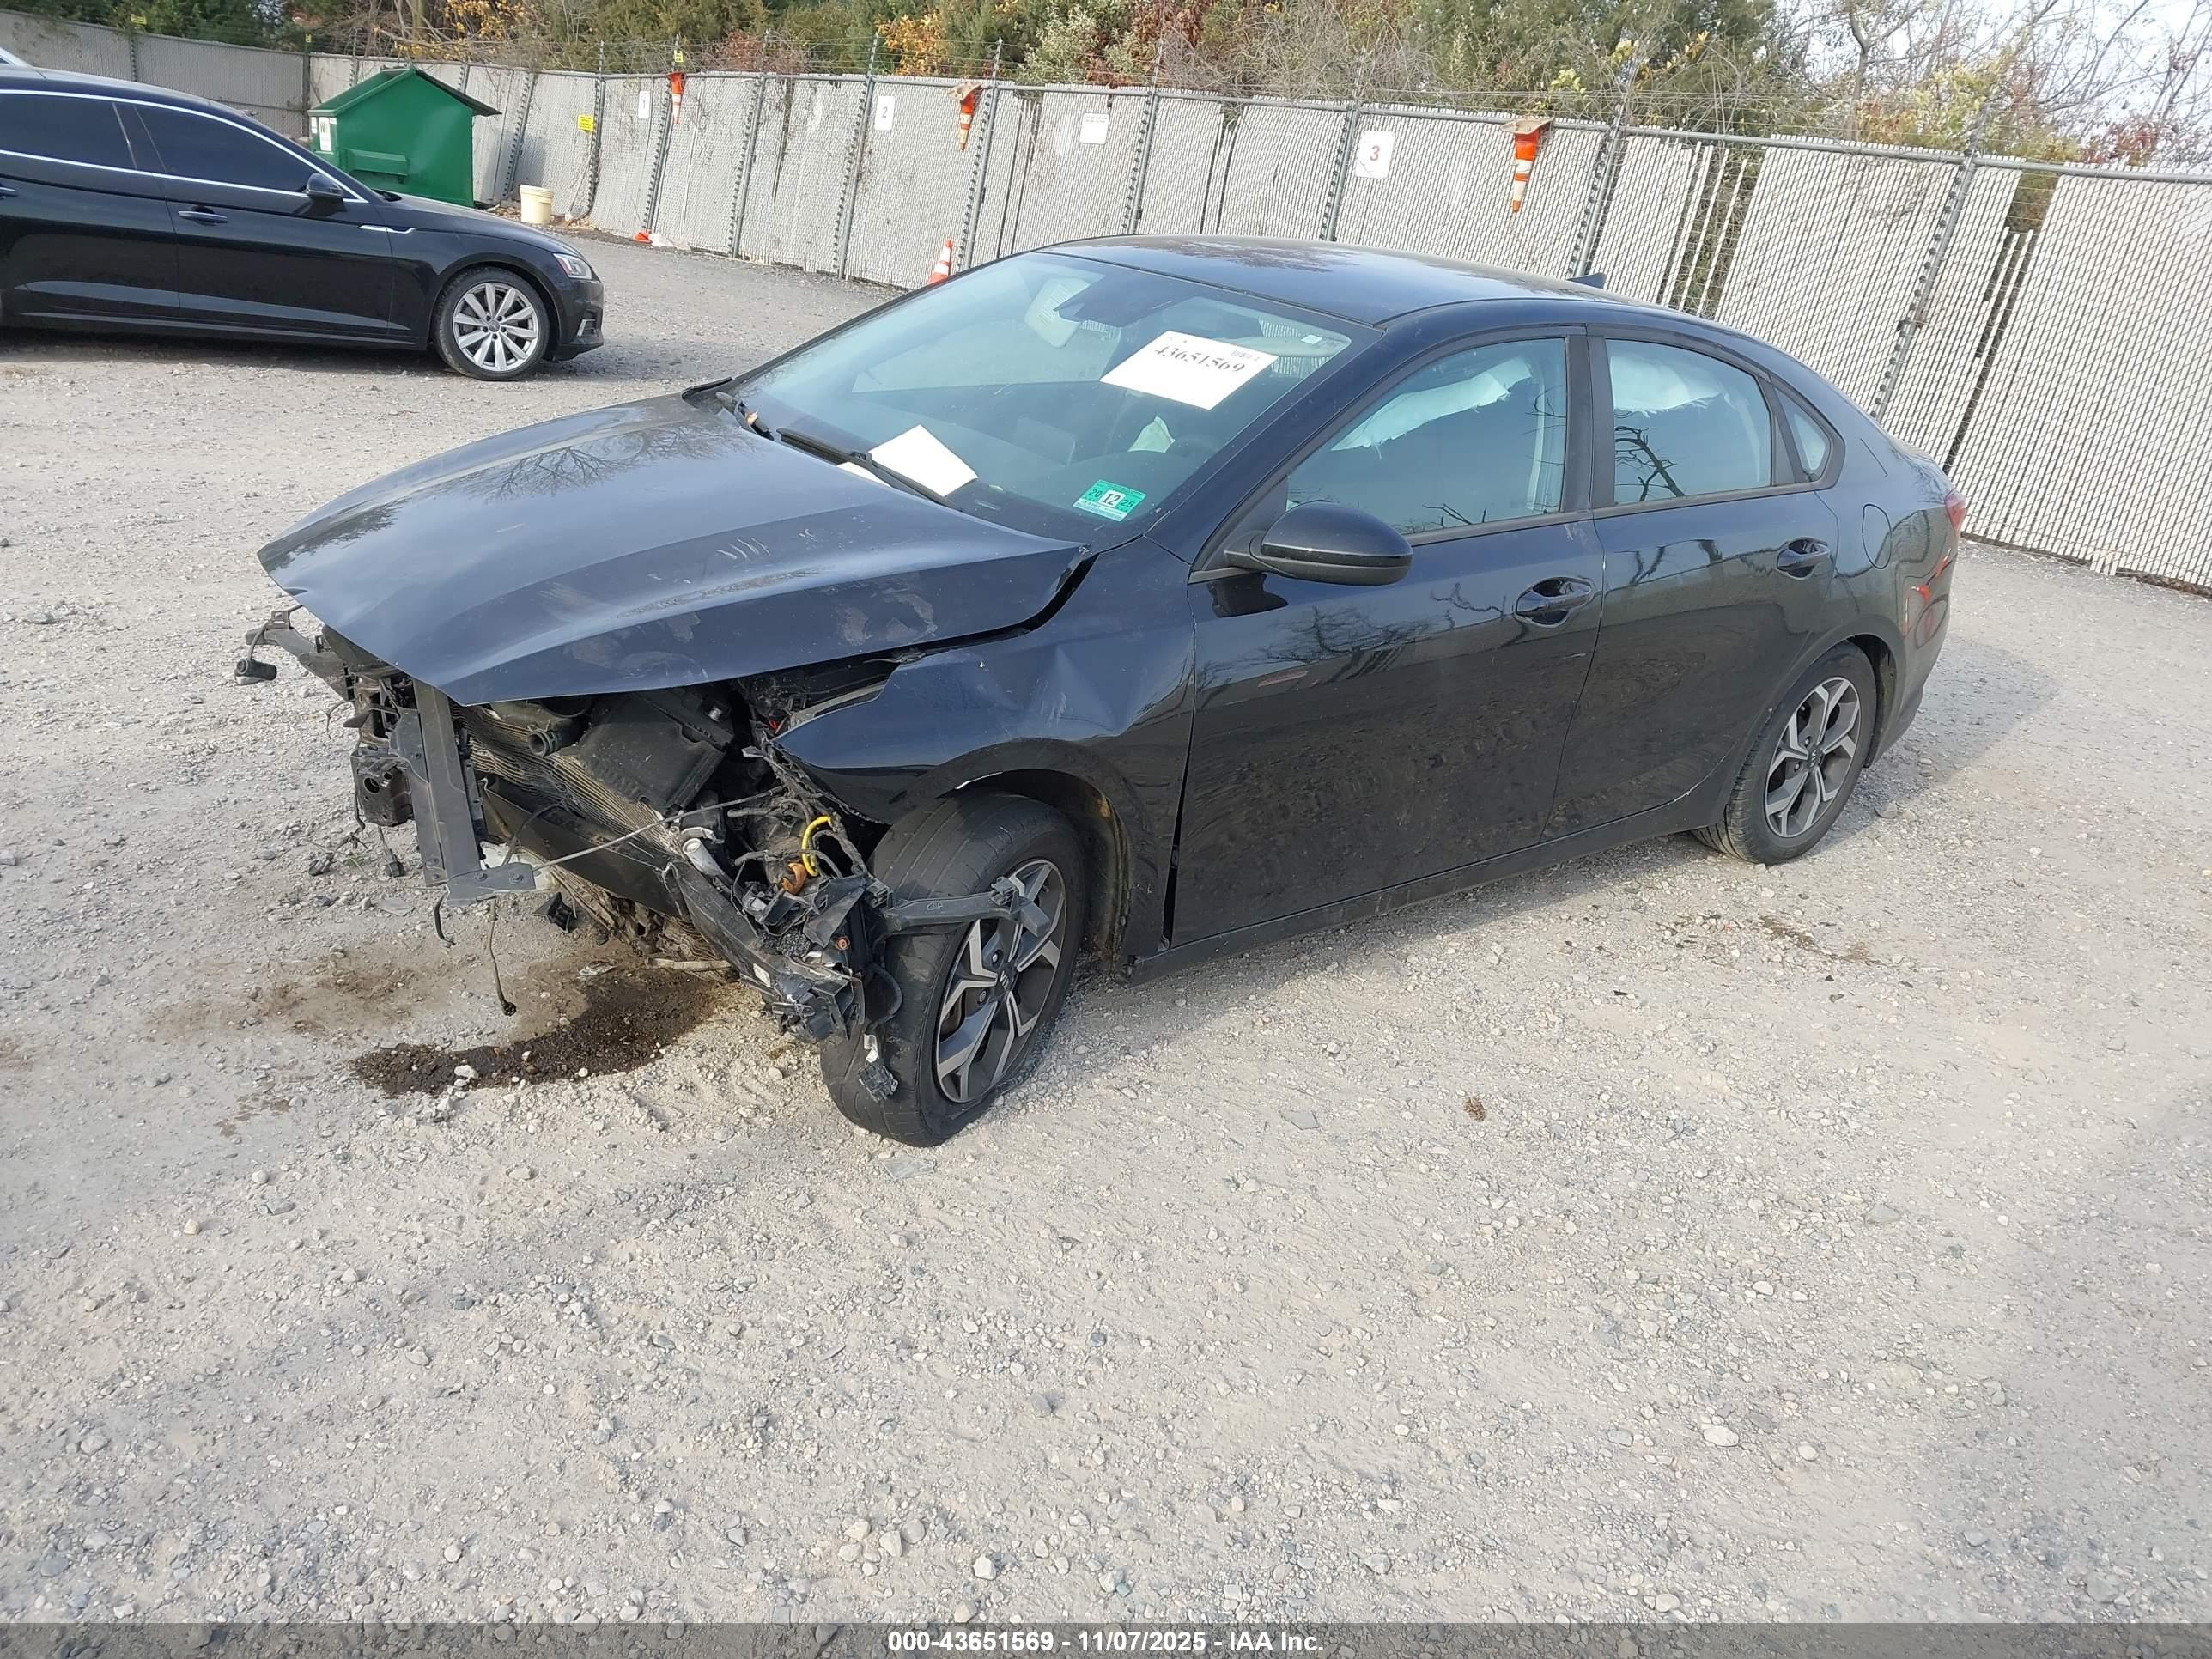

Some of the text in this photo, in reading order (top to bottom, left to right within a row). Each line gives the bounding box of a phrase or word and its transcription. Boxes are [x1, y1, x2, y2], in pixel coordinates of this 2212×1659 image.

[881, 106, 888, 118] 2
[1370, 145, 1380, 161] 3
[1154, 345, 1245, 372] 43651569
[1089, 489, 1102, 498] 20
[1101, 493, 1121, 506] 12
[1120, 499, 1134, 508] 25
